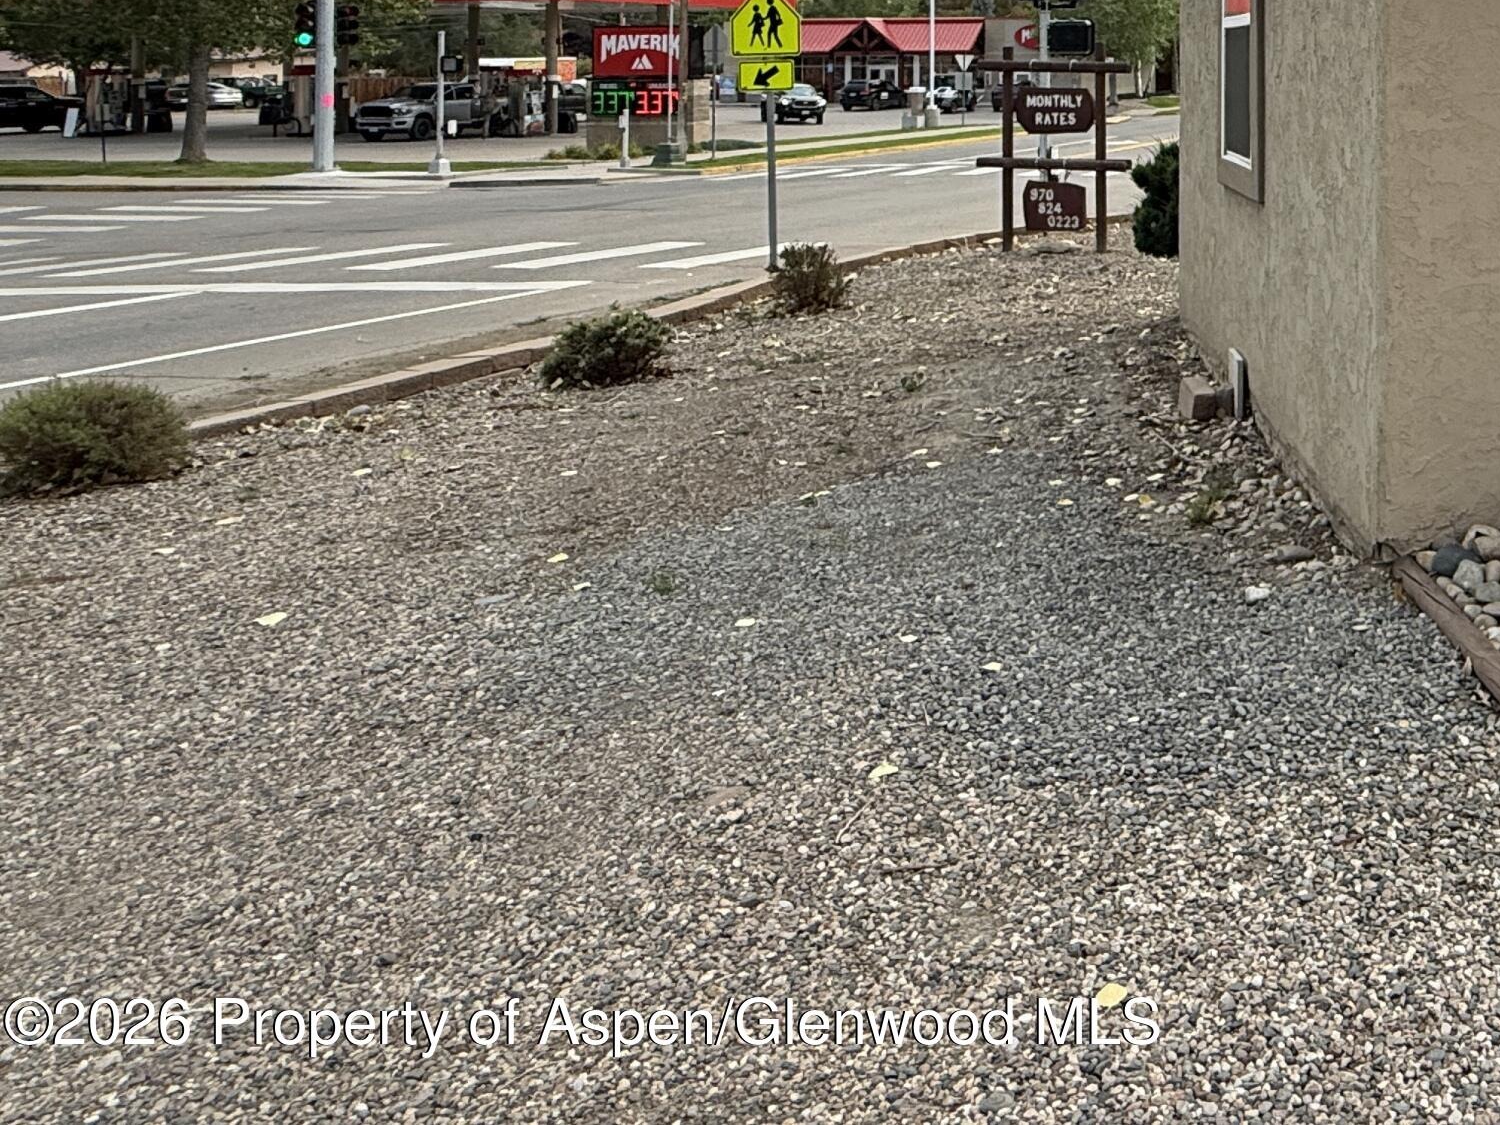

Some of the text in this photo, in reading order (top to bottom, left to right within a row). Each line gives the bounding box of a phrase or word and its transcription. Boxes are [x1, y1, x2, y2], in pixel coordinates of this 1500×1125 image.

[600, 34, 680, 63] MAVERIK
[1026, 94, 1083, 108] MONTHLY
[1034, 111, 1077, 125] RATES
[1029, 188, 1054, 201] 970
[1038, 202, 1062, 215] 824
[1046, 216, 1080, 228] 0223
